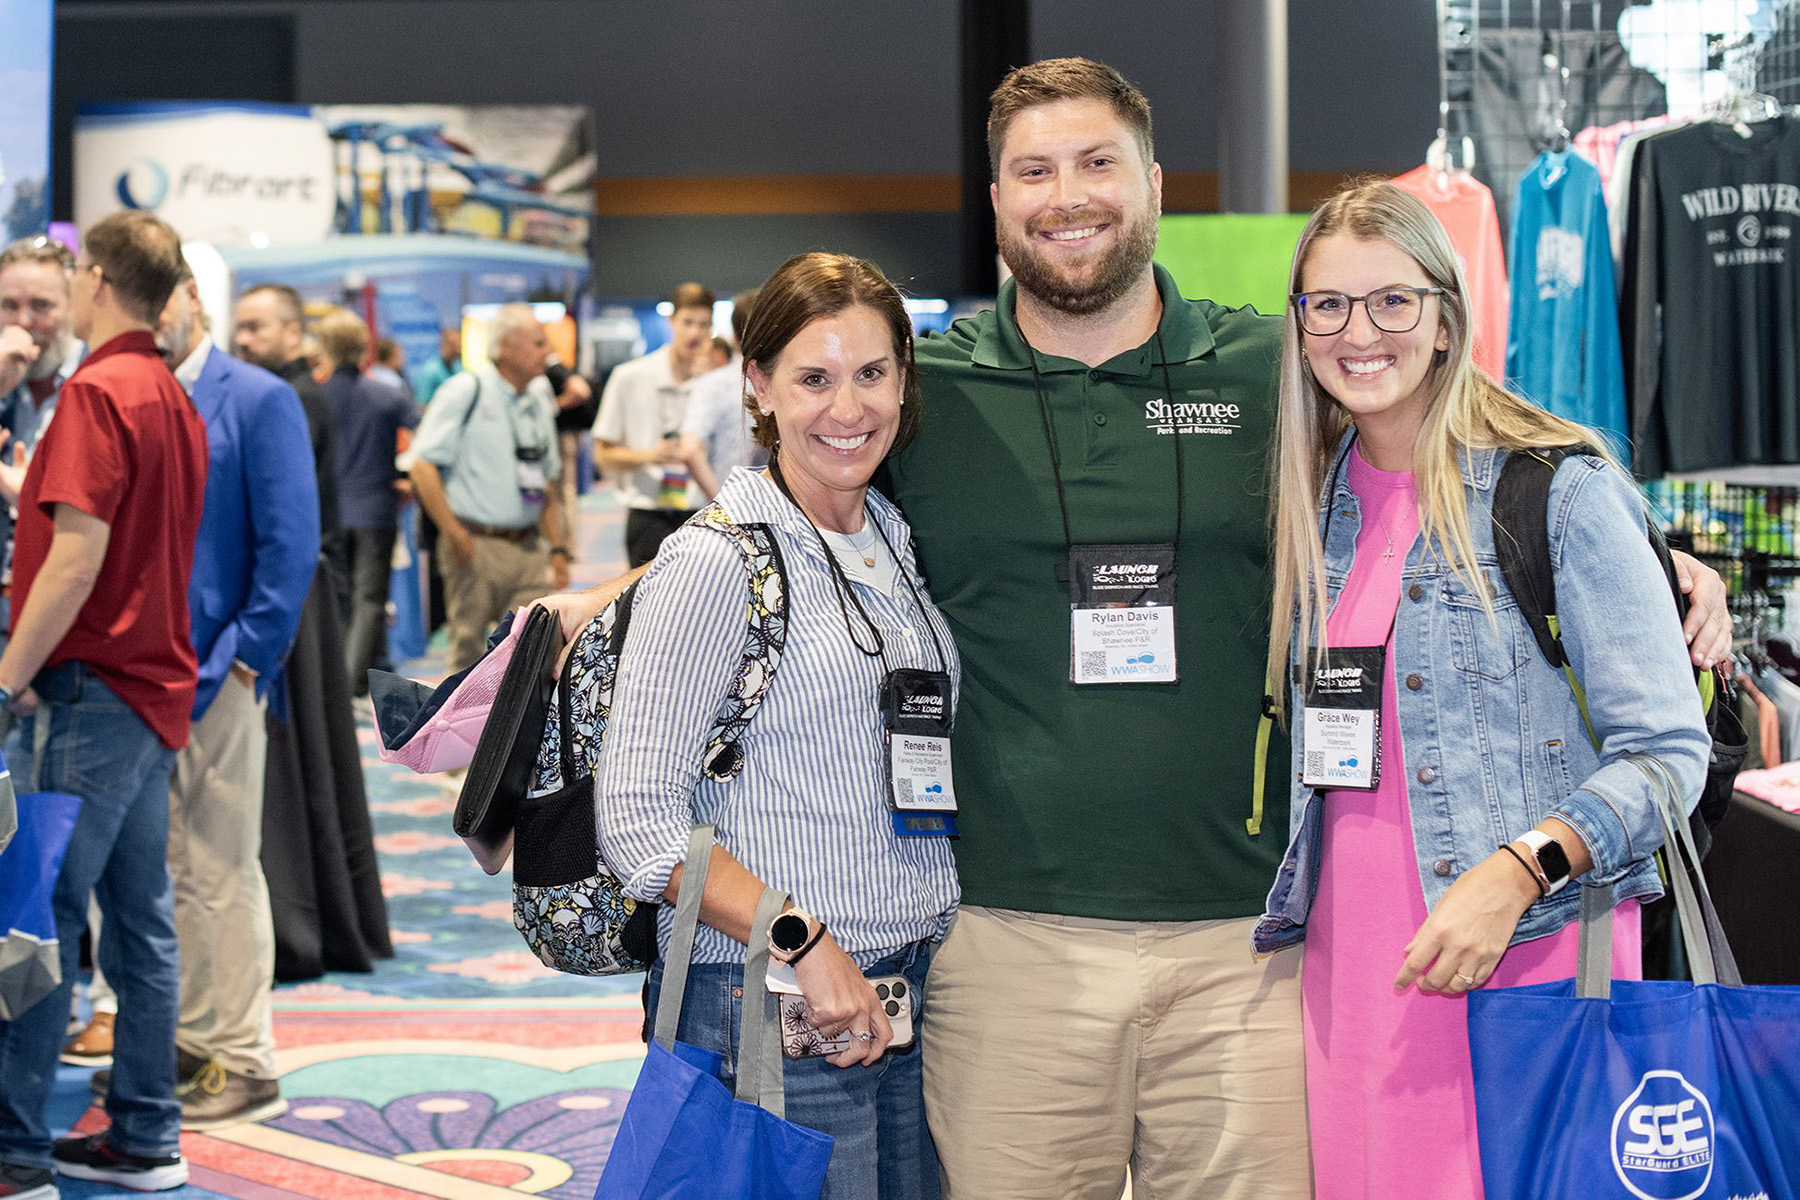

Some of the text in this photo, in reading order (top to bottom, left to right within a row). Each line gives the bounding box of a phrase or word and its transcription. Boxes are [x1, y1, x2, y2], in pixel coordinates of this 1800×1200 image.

[1682, 183, 1800, 221] WILD RIVER
[1145, 398, 1240, 419] Shawnee
[1179, 426, 1192, 434] and
[1194, 426, 1232, 434] Recreation
[1099, 564, 1159, 574] LAUNCH
[1092, 611, 1159, 624] Rylan Davis
[1102, 637, 1134, 645] Shawnee
[1318, 712, 1360, 726] Grace Wey
[904, 740, 942, 752] Renee Reis
[1624, 1099, 1709, 1156] SGE
[1622, 1151, 1711, 1168] StarGuard ELITE
